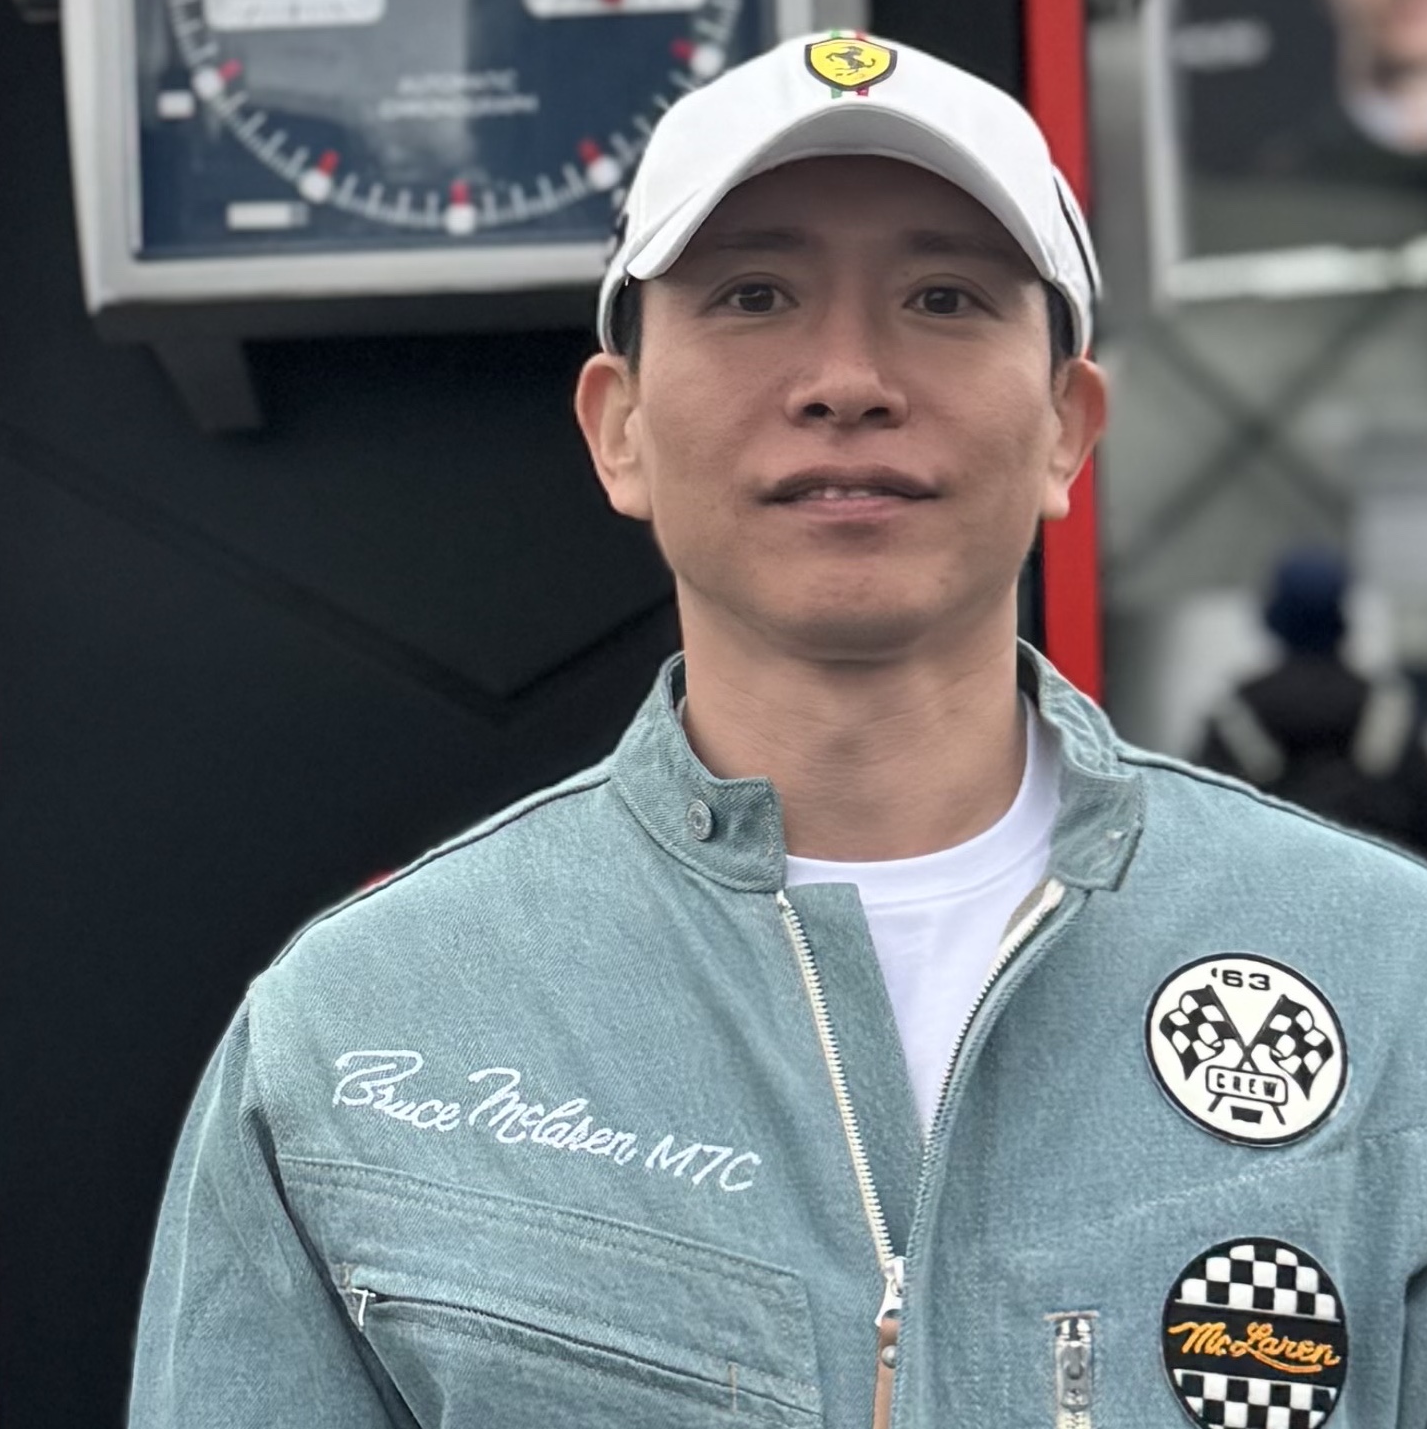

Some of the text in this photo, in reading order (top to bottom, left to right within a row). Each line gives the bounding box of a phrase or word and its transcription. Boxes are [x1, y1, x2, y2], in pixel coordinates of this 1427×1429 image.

[1211, 967, 1271, 991] '63
[1217, 1073, 1277, 1098] CREW
[333, 1050, 762, 1193] Bruce McLaren M7C
[1168, 1322, 1341, 1373] McLaren
